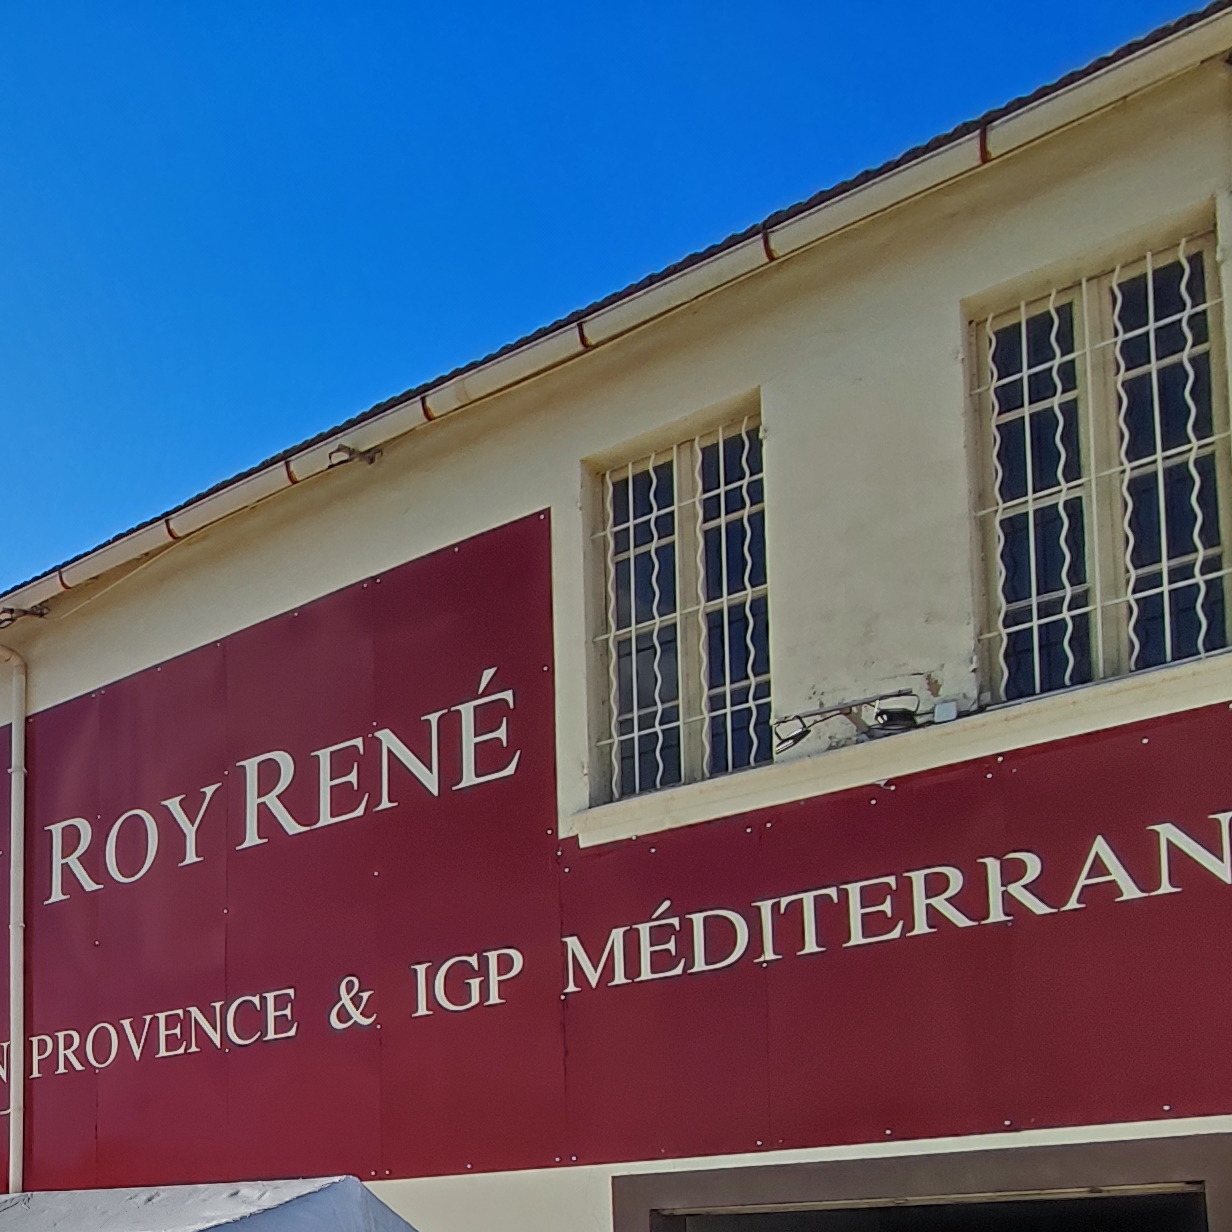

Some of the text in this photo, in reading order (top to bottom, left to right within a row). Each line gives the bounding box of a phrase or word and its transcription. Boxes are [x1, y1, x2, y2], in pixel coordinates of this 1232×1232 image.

[43, 782, 223, 906] ROY
[235, 666, 521, 851] RENÉ
[28, 987, 298, 1079] PROVENCE
[329, 976, 377, 1030] &
[410, 948, 524, 1018] IGP
[560, 810, 1232, 993] MÉDITERRAN
